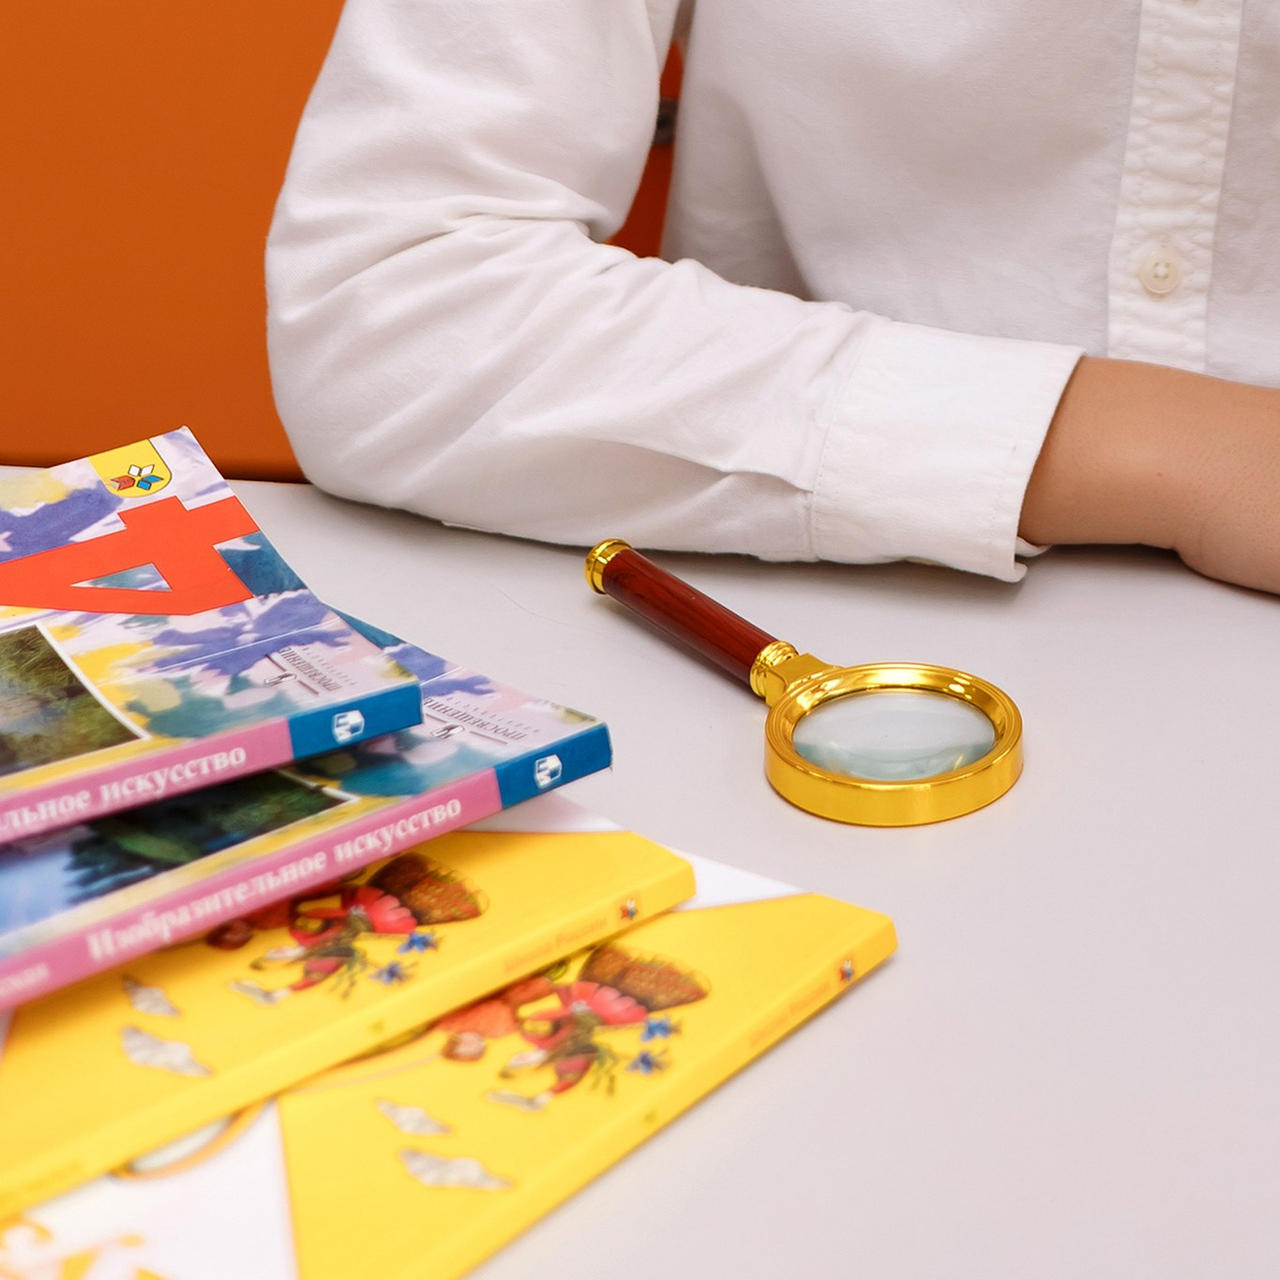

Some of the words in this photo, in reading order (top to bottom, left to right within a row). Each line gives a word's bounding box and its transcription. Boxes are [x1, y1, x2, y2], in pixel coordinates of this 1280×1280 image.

[100, 746, 247, 799] искусство
[86, 850, 327, 961] Изобразительное
[333, 798, 462, 853] искусство
